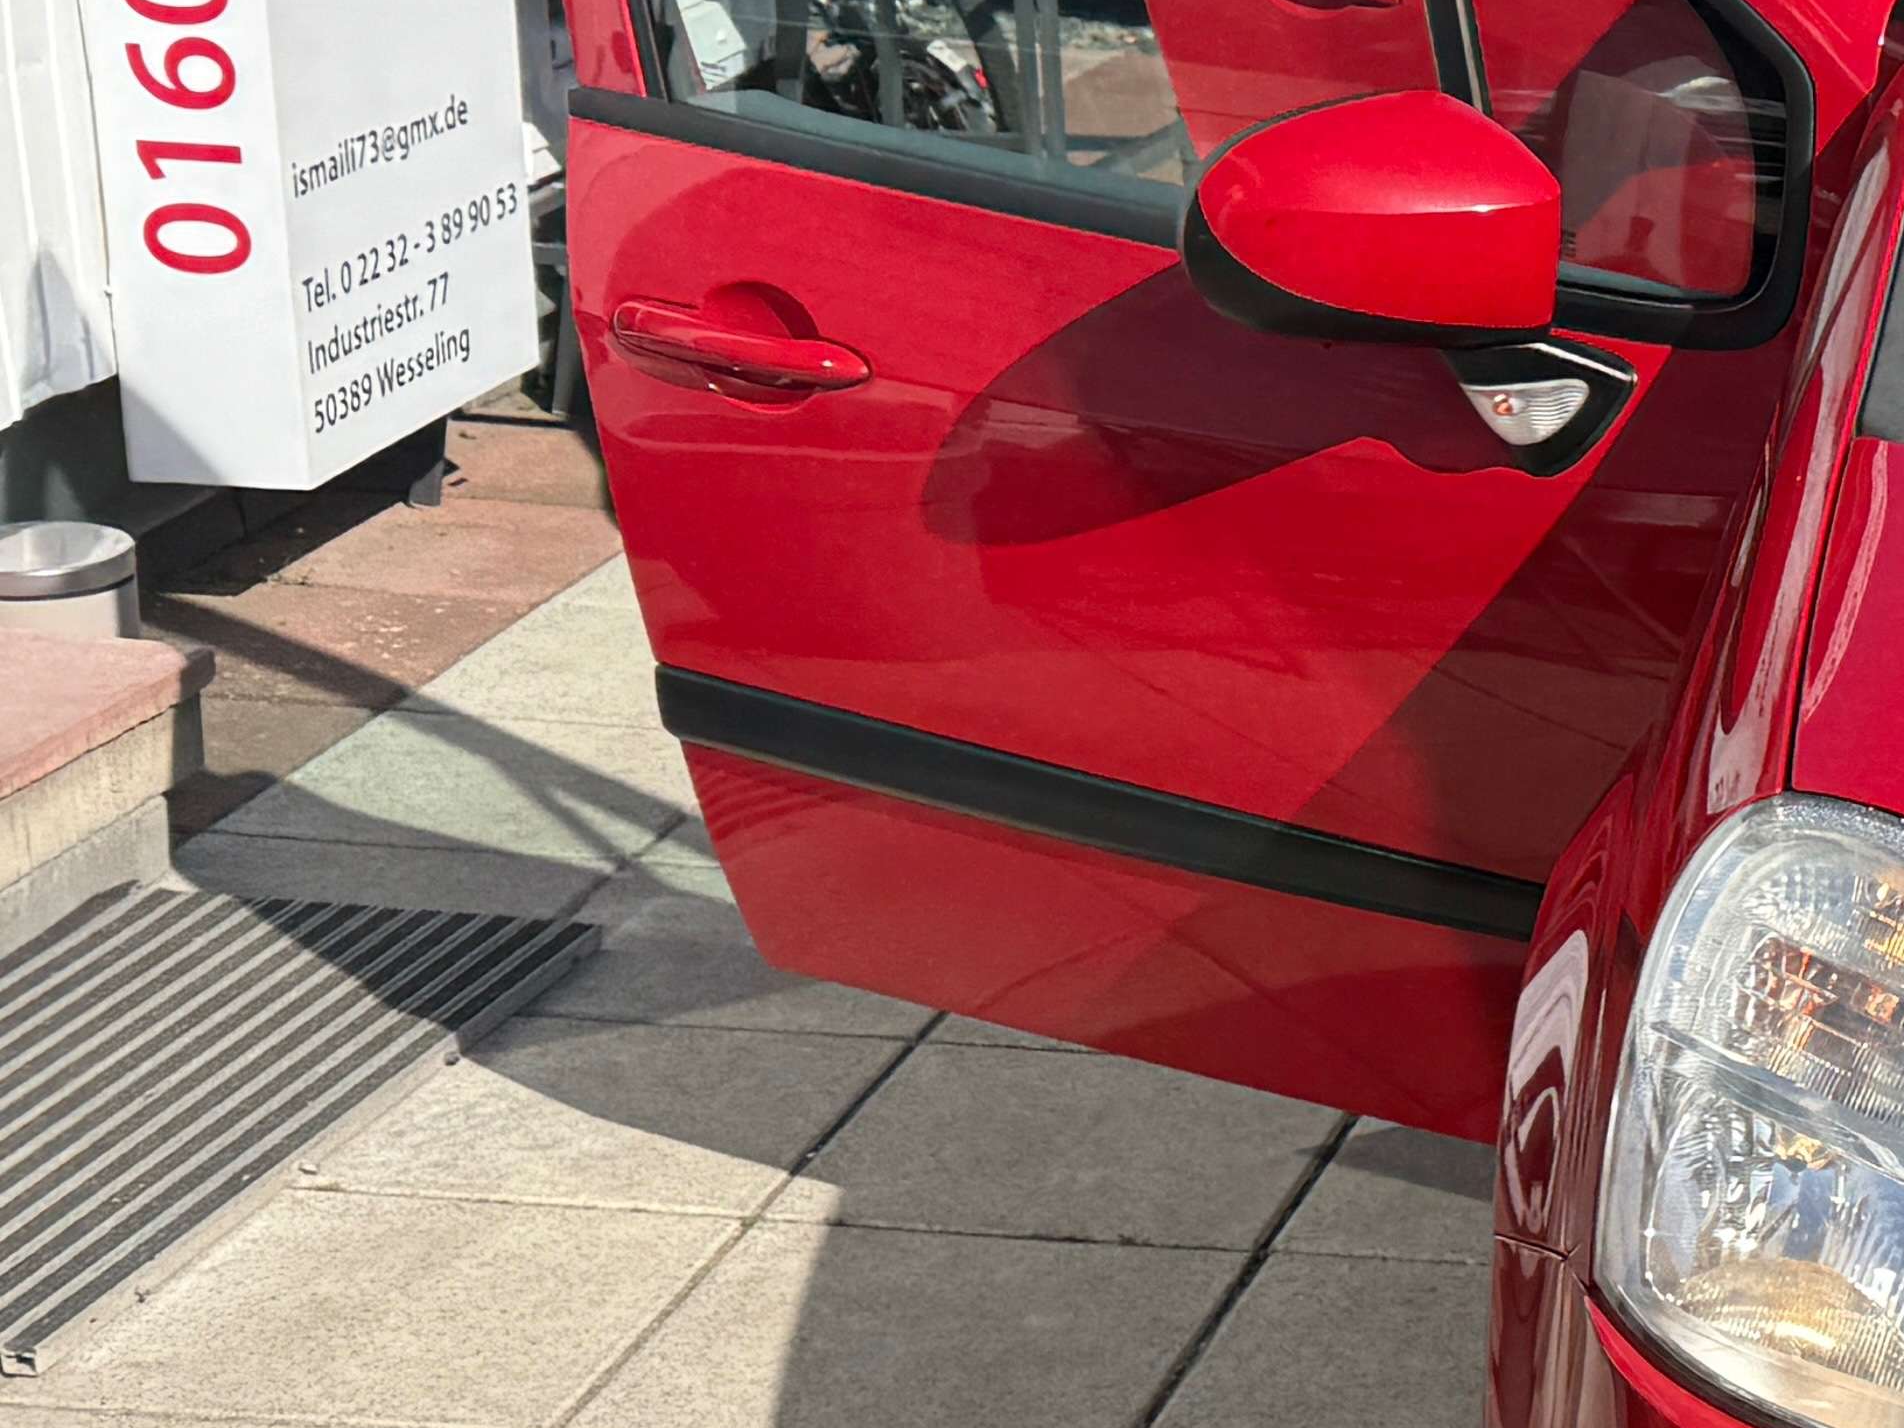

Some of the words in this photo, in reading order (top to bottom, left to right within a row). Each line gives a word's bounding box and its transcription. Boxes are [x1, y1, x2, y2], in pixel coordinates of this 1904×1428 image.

[291, 94, 469, 199] ismaili73@gmx.de
[302, 266, 337, 313] Tel.
[340, 260, 352, 295] 0
[357, 246, 381, 287] 22
[385, 233, 410, 274] 32
[425, 220, 436, 254] 3
[441, 208, 463, 246] 89
[469, 194, 491, 233] 90
[495, 182, 518, 221] 53
[307, 294, 424, 375] Industriestr.
[427, 271, 450, 313] 77
[314, 373, 373, 434] 50389
[376, 327, 471, 398] Wesseling
